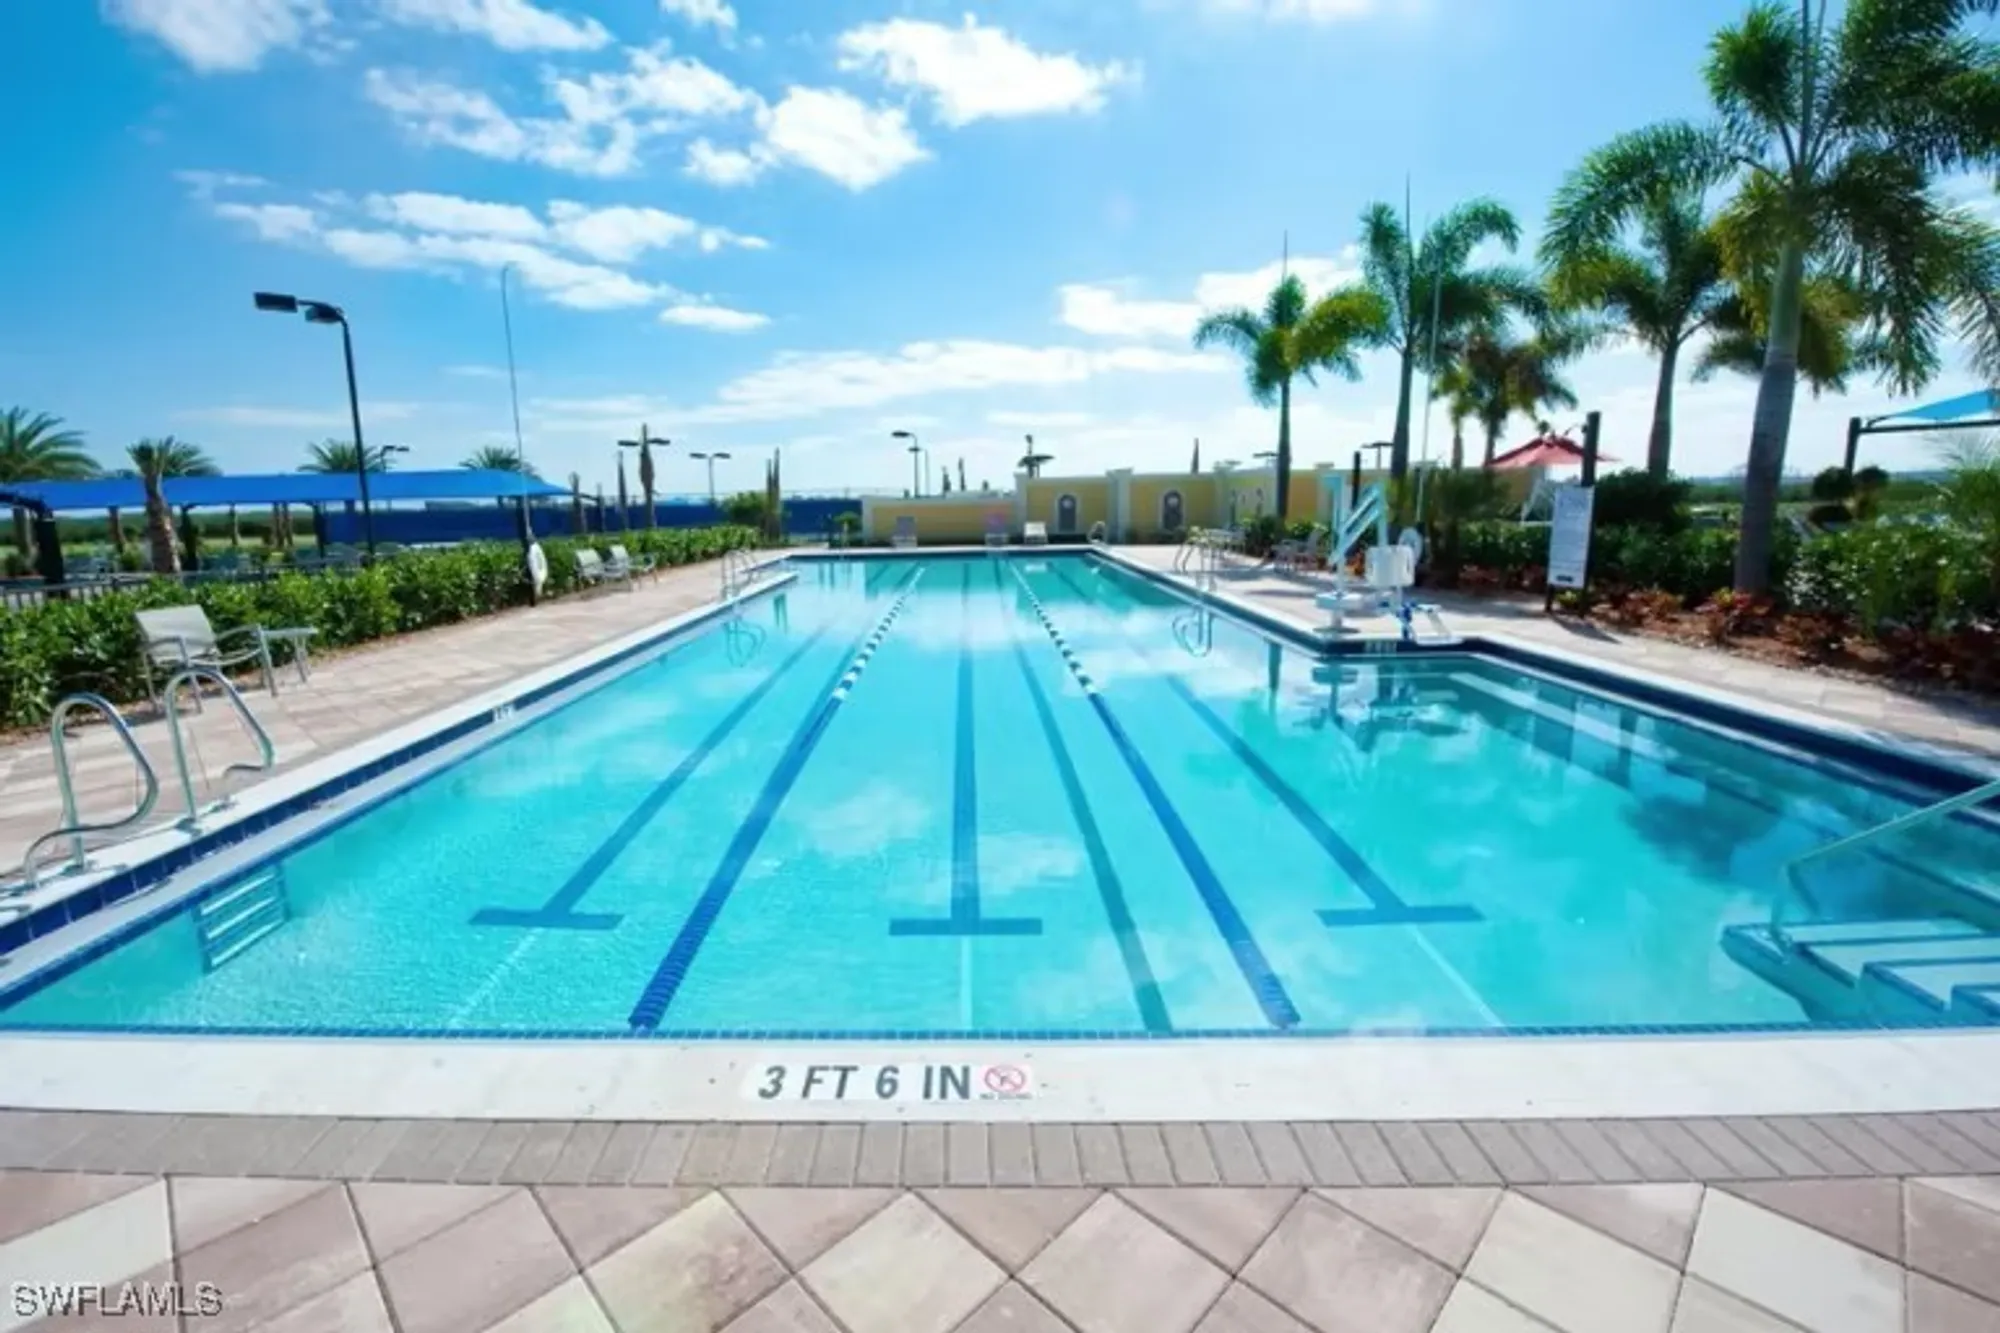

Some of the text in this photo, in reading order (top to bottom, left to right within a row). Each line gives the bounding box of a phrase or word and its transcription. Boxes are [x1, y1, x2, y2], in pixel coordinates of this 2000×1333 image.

[758, 1065, 971, 1099] 3 FT 6 IN
